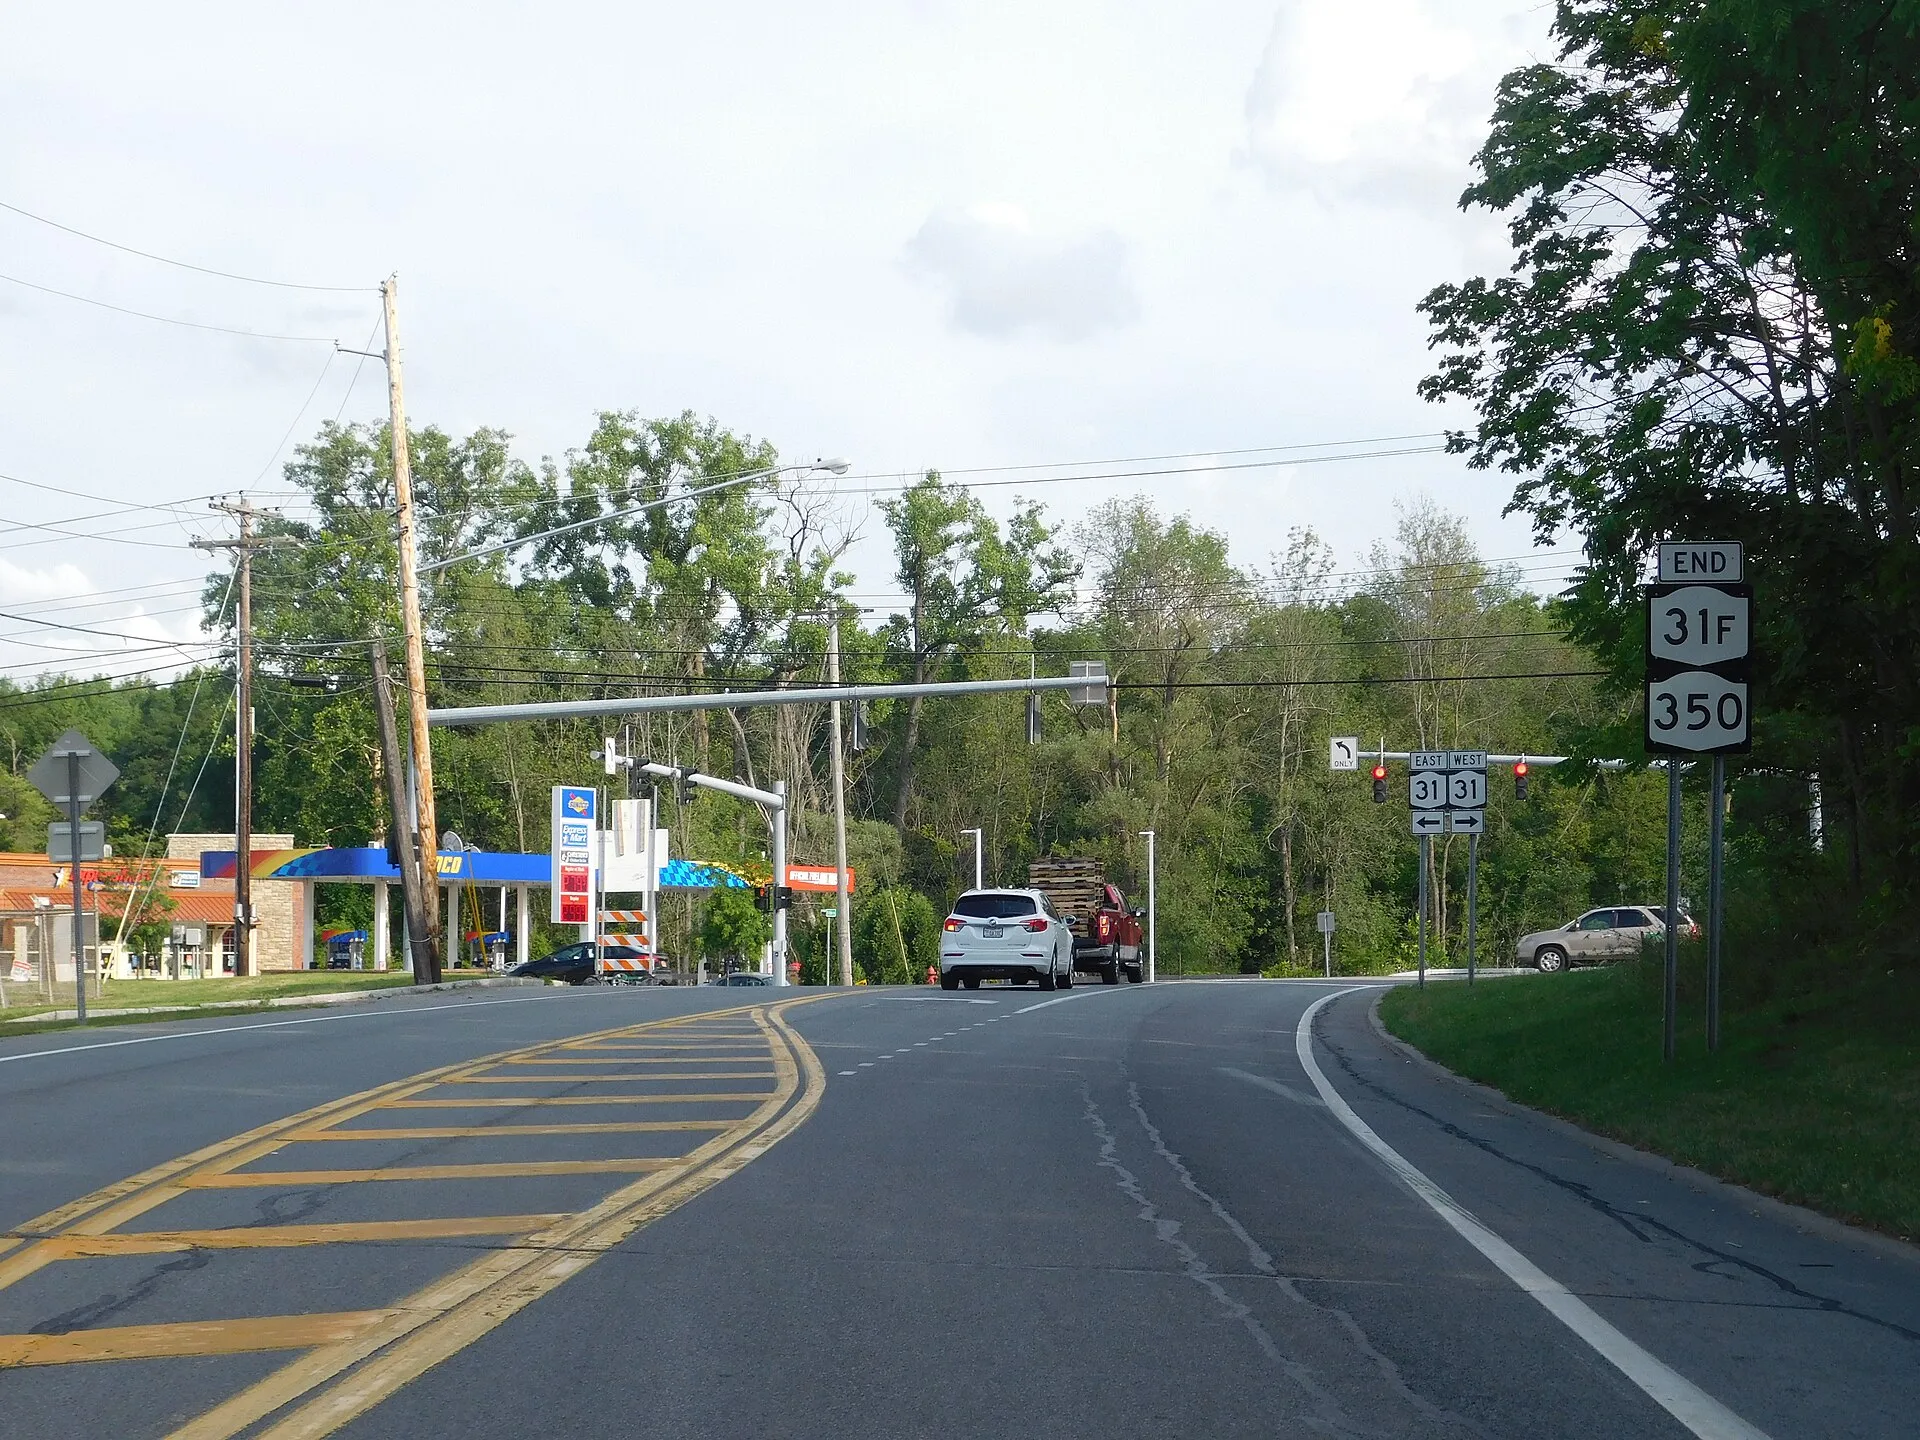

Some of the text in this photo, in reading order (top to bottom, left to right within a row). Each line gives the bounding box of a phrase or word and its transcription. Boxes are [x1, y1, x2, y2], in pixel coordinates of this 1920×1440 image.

[1674, 551, 1727, 574] END
[1663, 608, 1736, 645] 31F
[1654, 692, 1743, 731] 350
[1334, 760, 1354, 768] ONLY
[1415, 755, 1442, 767] EAST
[1453, 754, 1482, 766] WEST
[1415, 780, 1438, 800] 31
[1454, 779, 1477, 799] 31
[563, 825, 587, 836] Express
[569, 833, 587, 842] Mart
